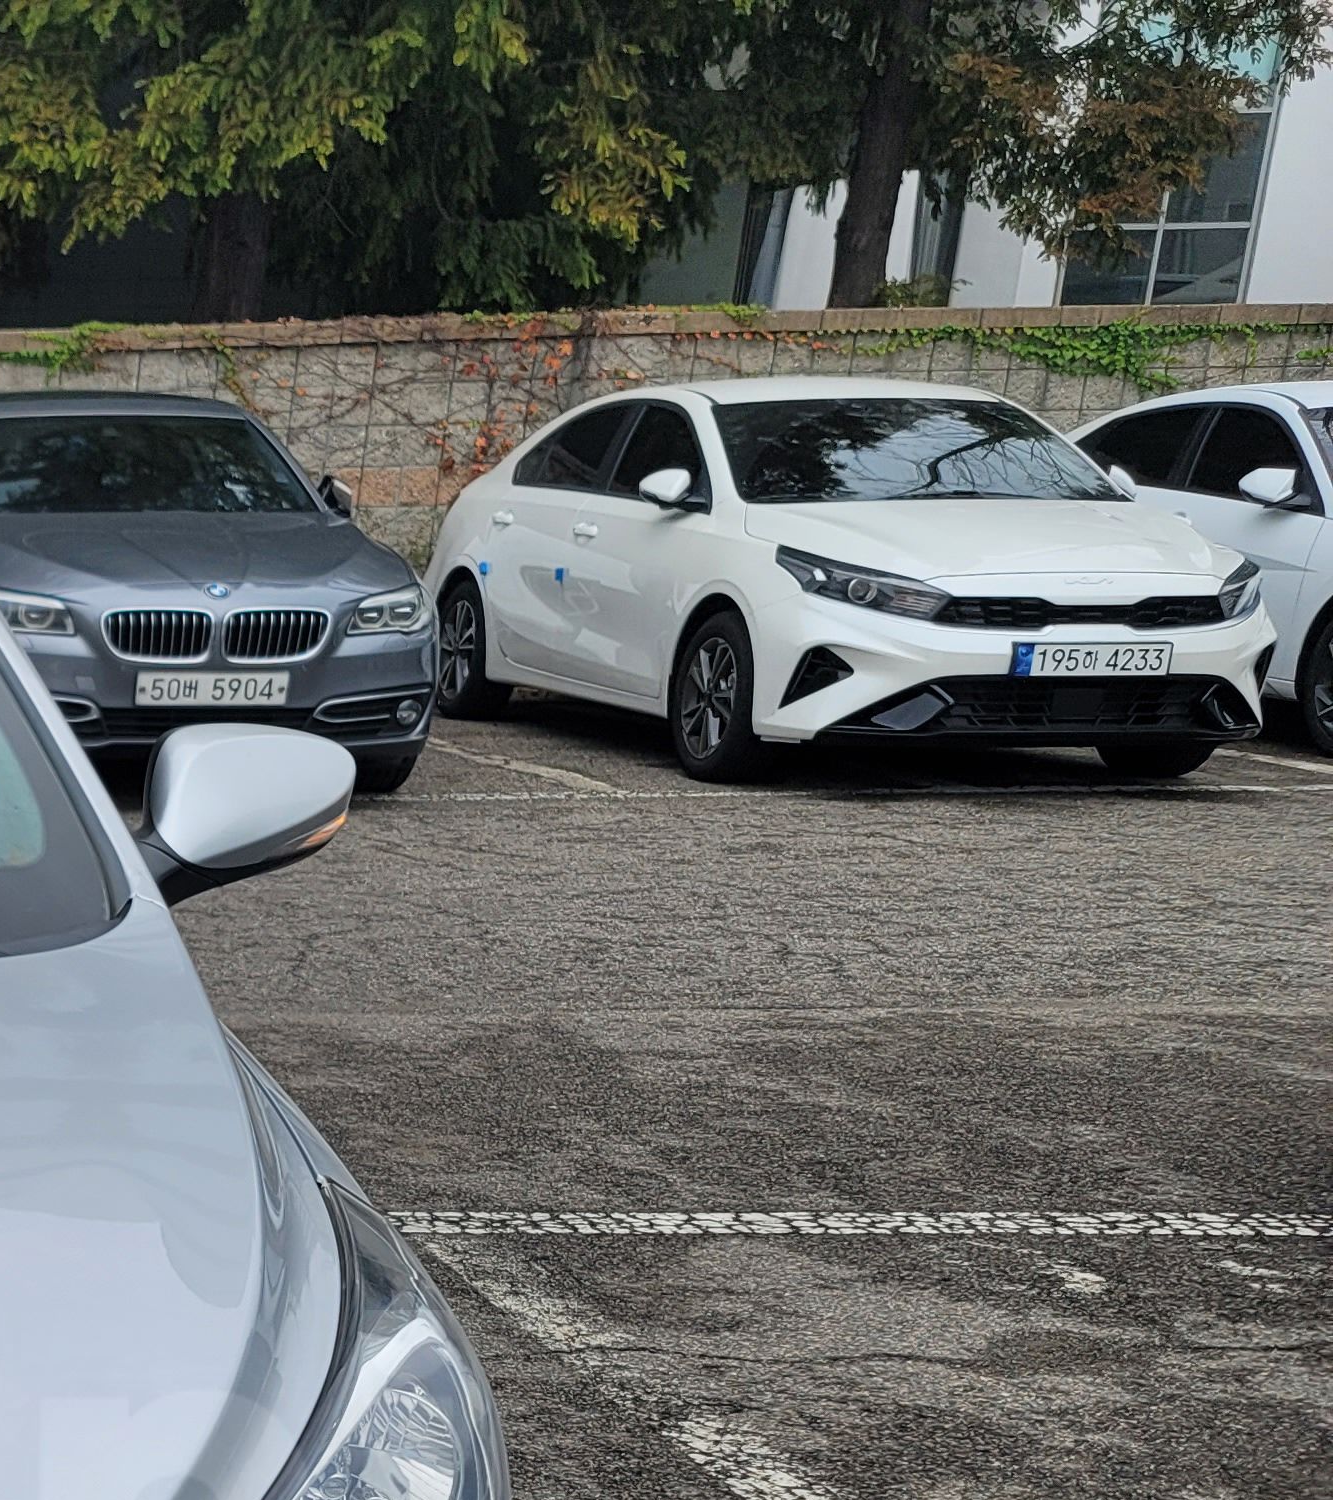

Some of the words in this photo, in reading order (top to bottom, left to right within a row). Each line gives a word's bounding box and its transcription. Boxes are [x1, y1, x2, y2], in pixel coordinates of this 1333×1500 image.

[1037, 648, 1099, 672] 195하
[1105, 648, 1166, 672] 4233
[149, 678, 199, 701] 50버
[210, 677, 274, 701] 5904
